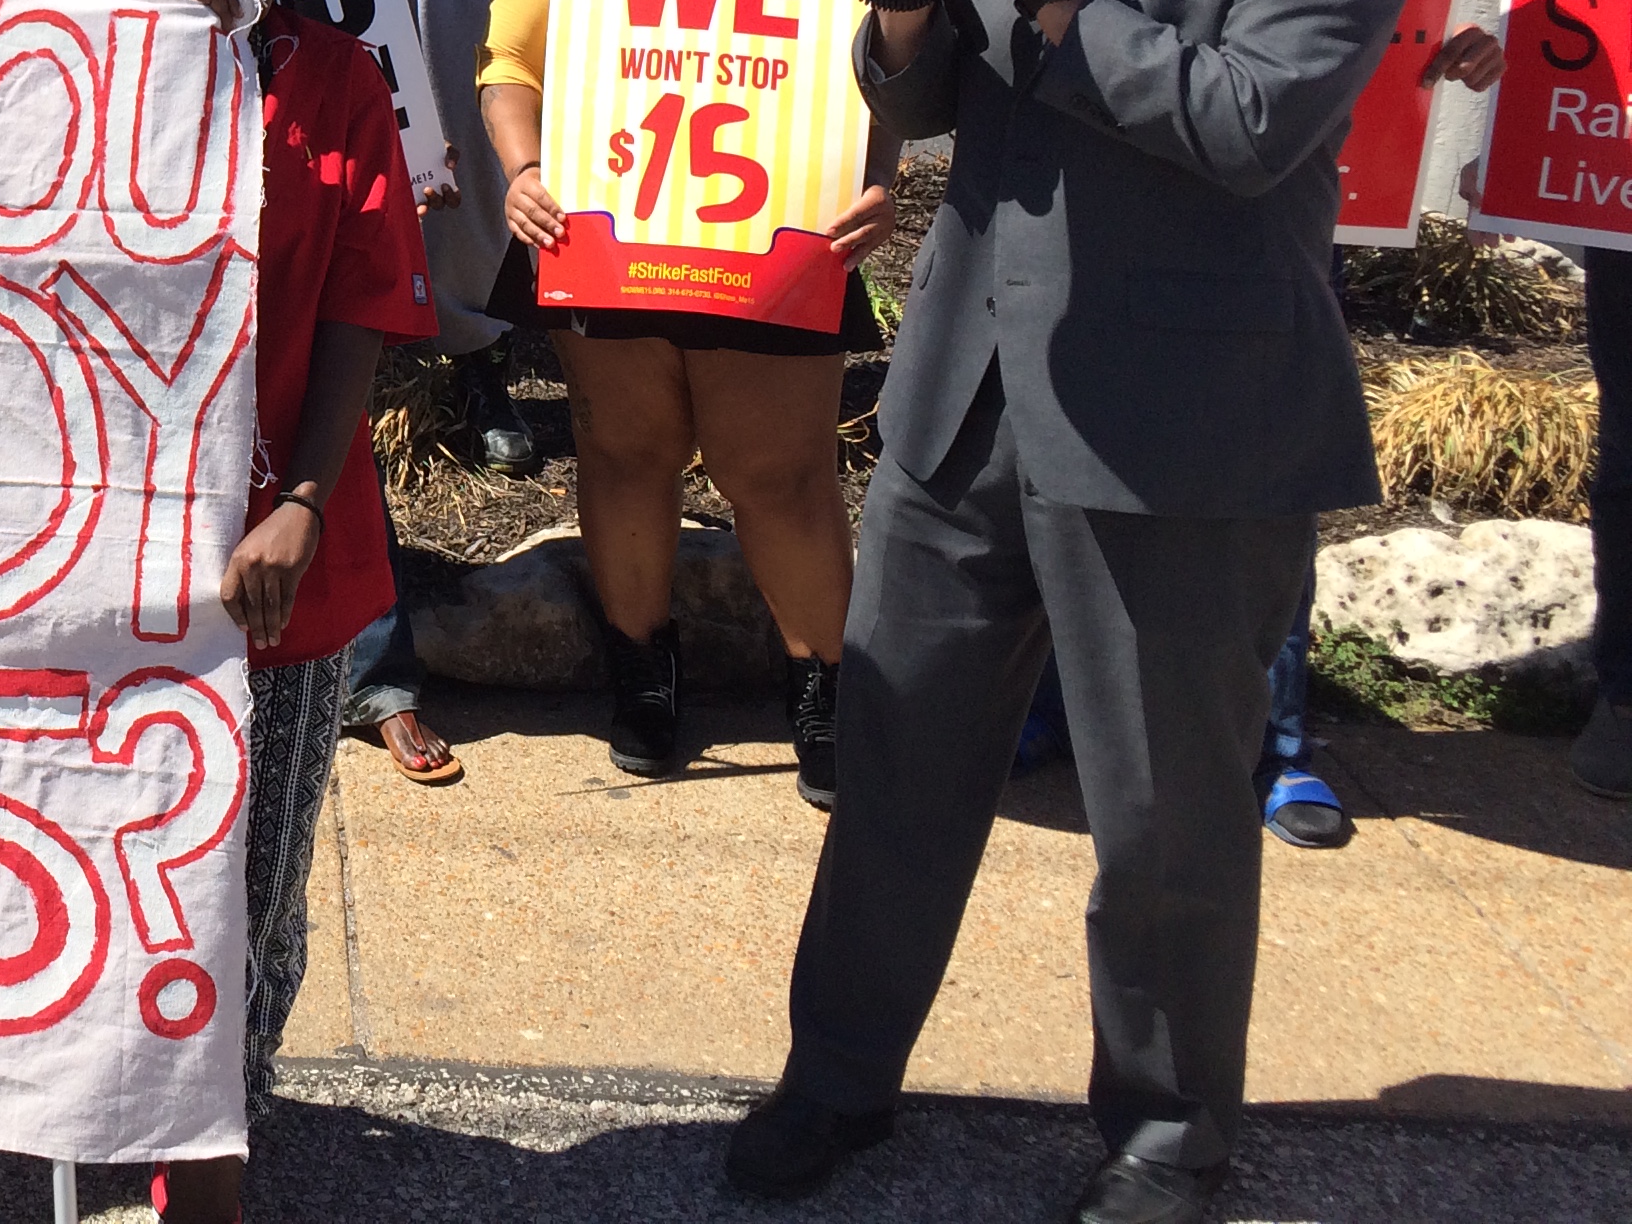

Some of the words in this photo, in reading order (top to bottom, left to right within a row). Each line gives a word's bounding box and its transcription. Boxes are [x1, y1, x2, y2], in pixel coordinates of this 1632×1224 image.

[620, 47, 711, 84] WON'T
[715, 52, 790, 91] STOP
[607, 92, 771, 224] $15
[627, 262, 752, 289] #StrikeFastFood
